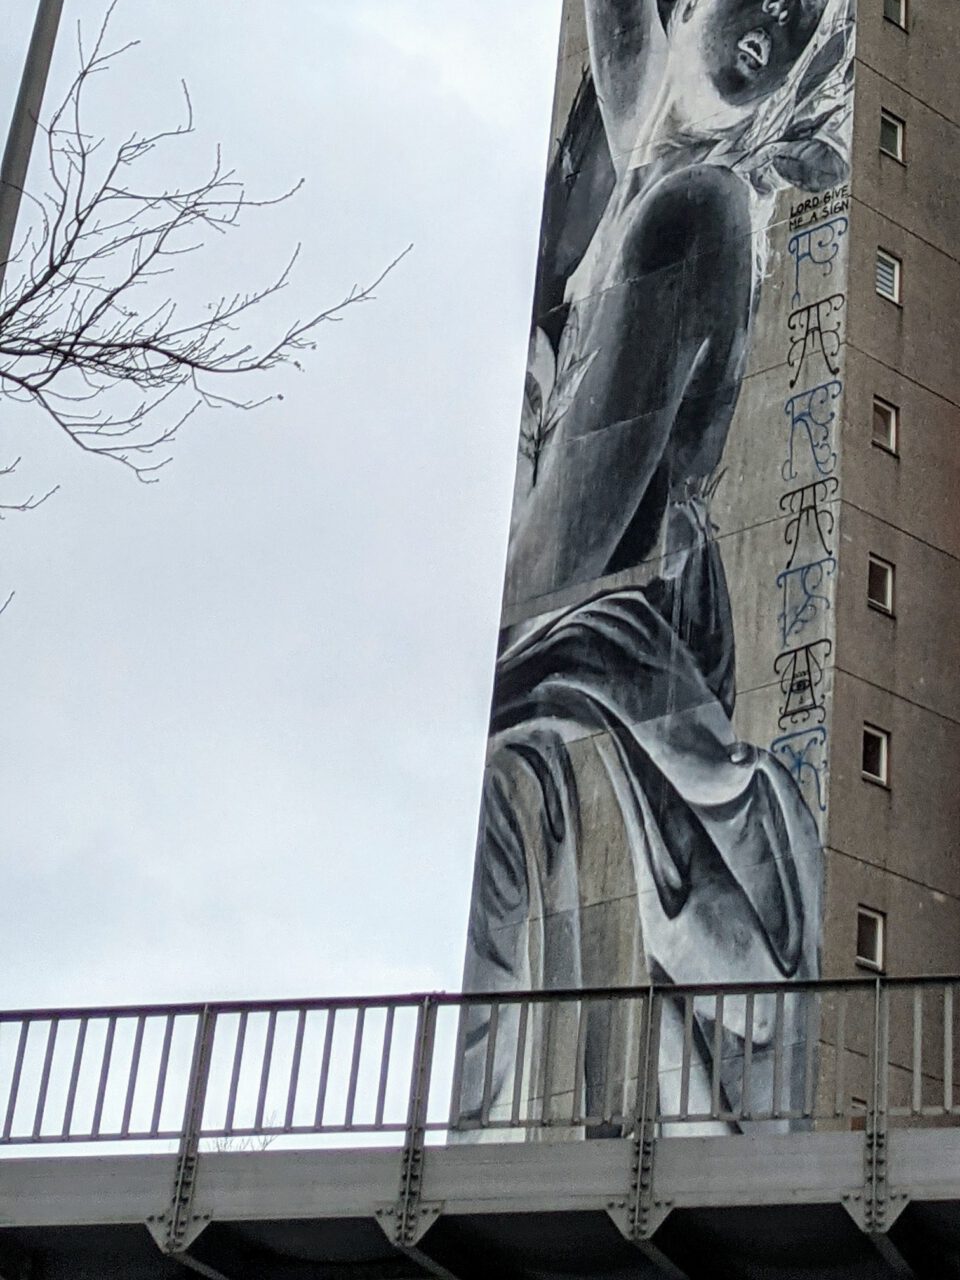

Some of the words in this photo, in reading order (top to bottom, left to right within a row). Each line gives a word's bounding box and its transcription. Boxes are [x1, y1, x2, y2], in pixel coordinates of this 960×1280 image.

[789, 217, 803, 231] ME
[810, 212, 817, 222] A
[822, 199, 849, 218] SIGN
[790, 196, 819, 217] LORD
[824, 185, 848, 203] GIVE
